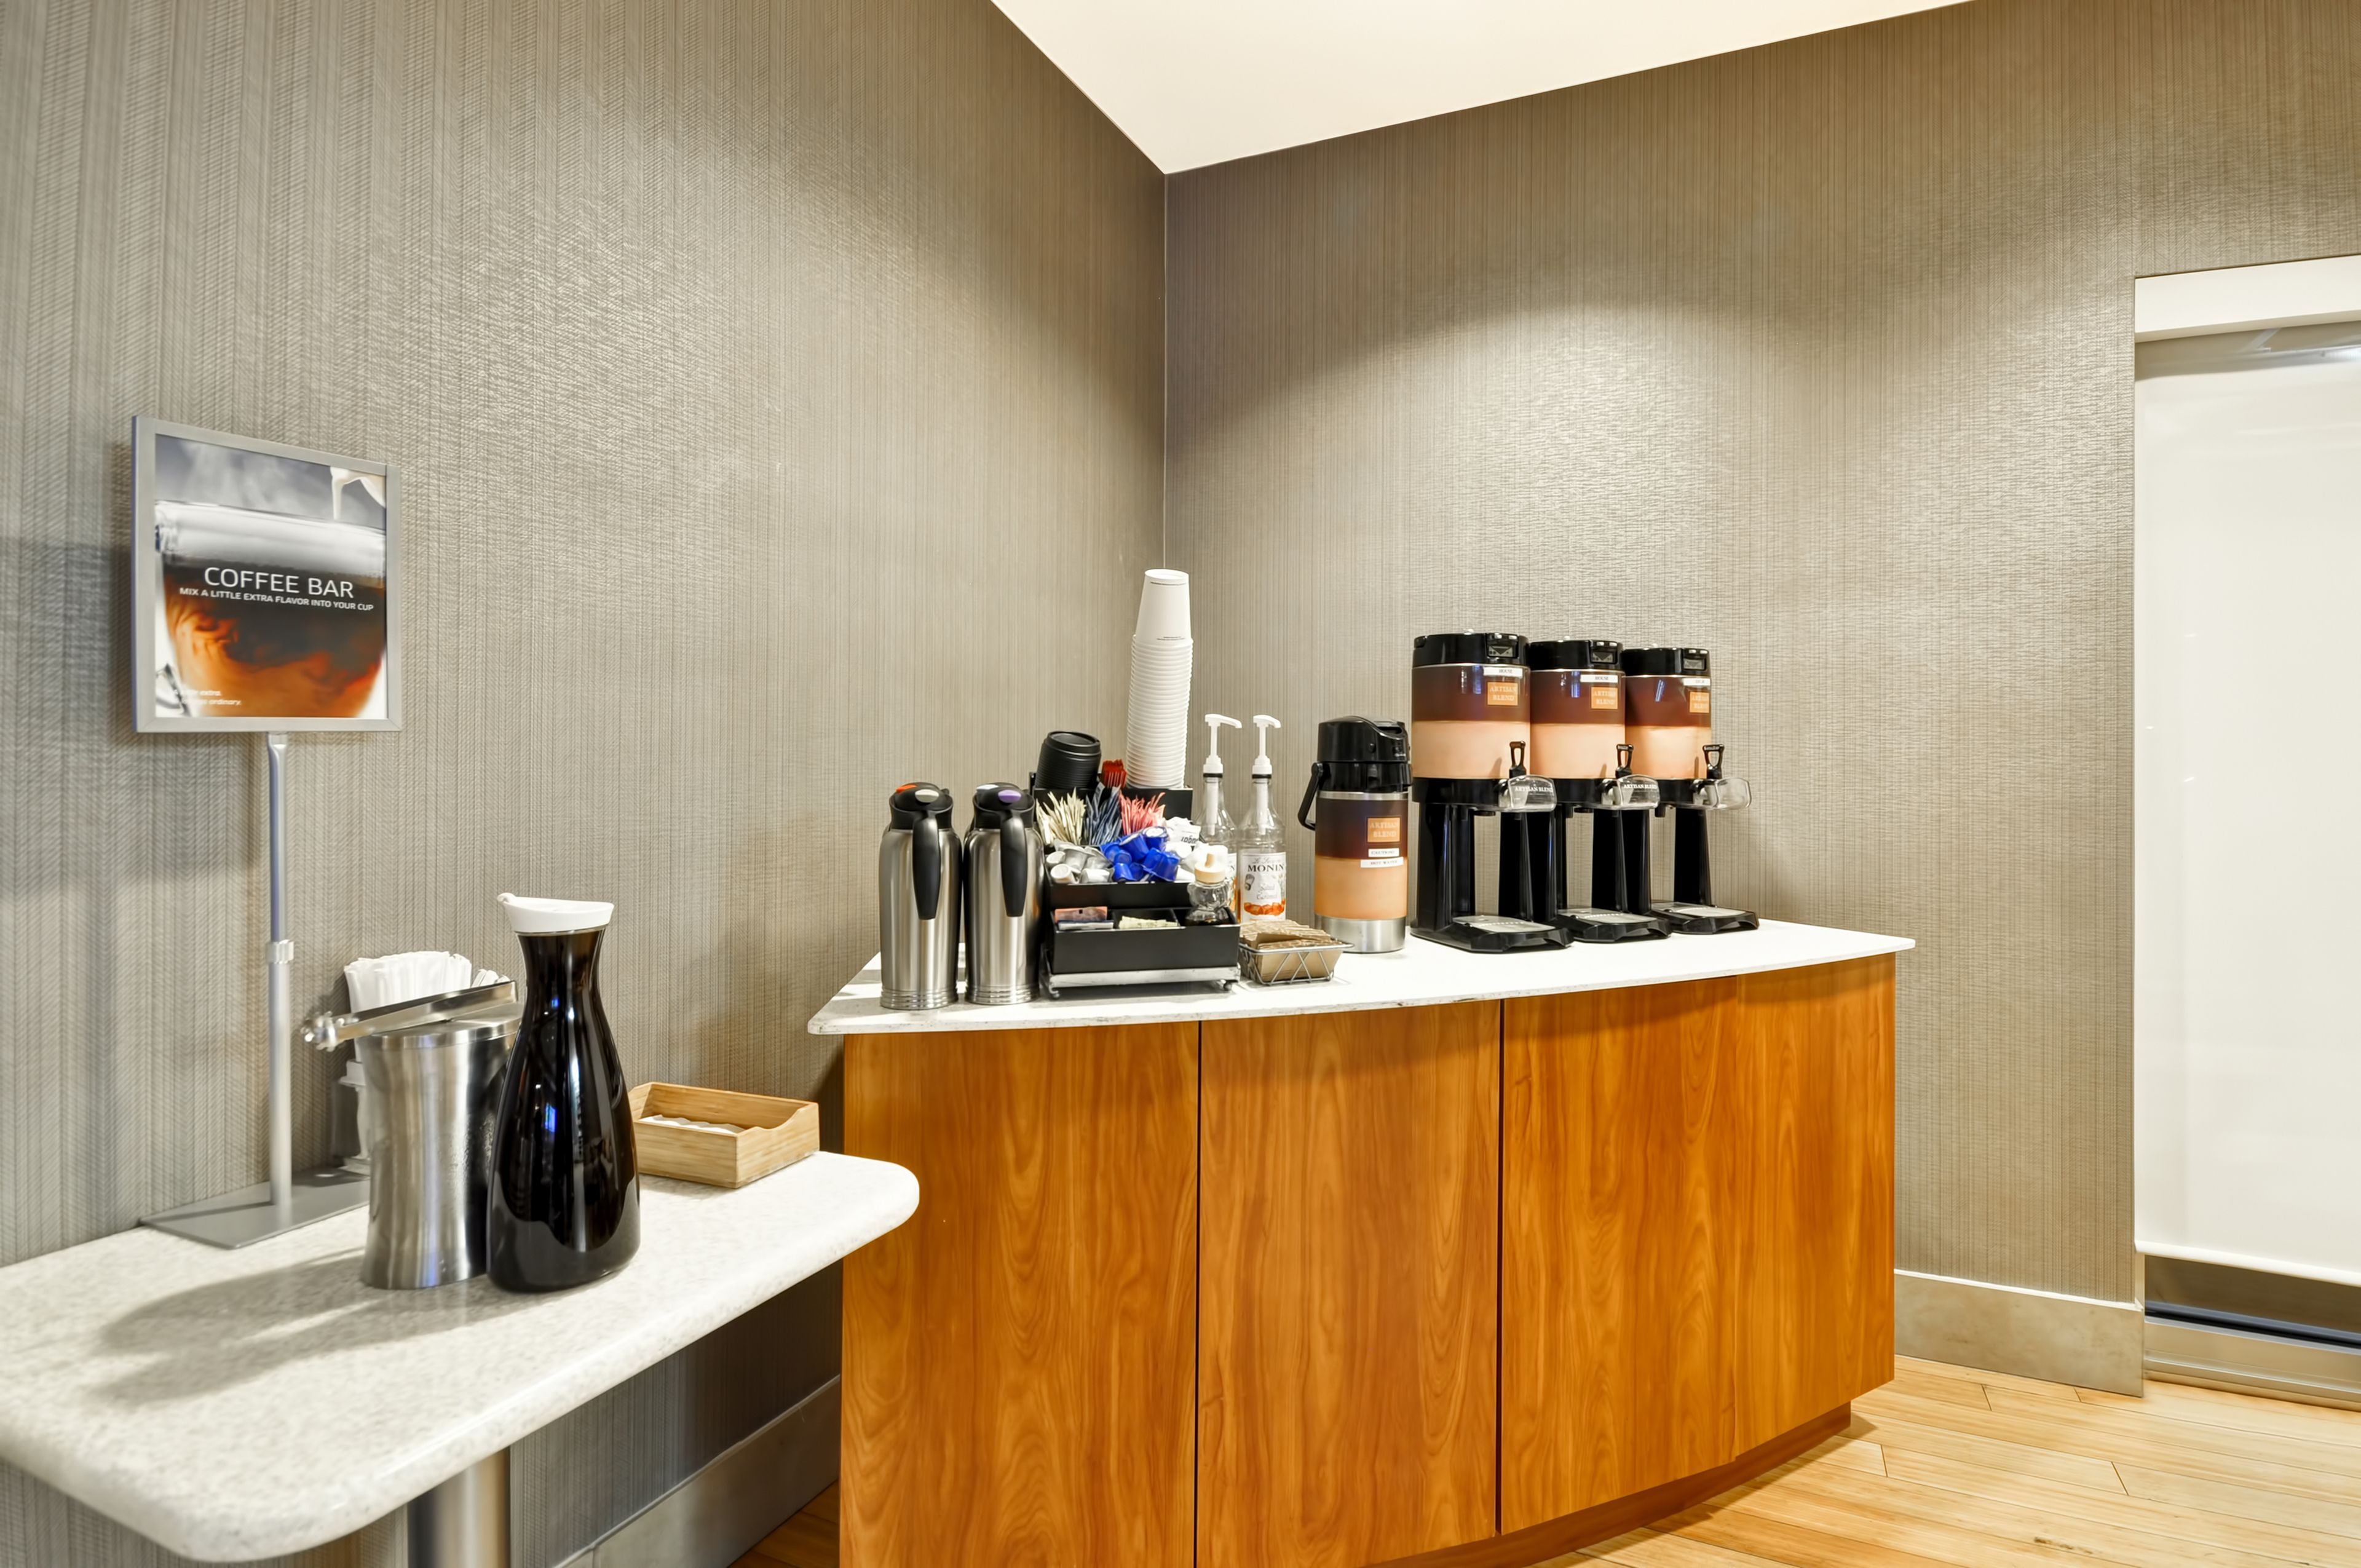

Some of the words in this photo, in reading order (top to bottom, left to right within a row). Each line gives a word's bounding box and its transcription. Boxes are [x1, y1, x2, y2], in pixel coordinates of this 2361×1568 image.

[204, 566, 300, 593] COFFEE
[308, 577, 354, 598] BAR
[179, 587, 199, 596] MIX
[210, 590, 242, 600] LITTLE
[243, 593, 274, 603] EXTRA
[275, 595, 309, 606] FLAVOR
[310, 599, 332, 608] INTO
[333, 601, 356, 609] YOUR
